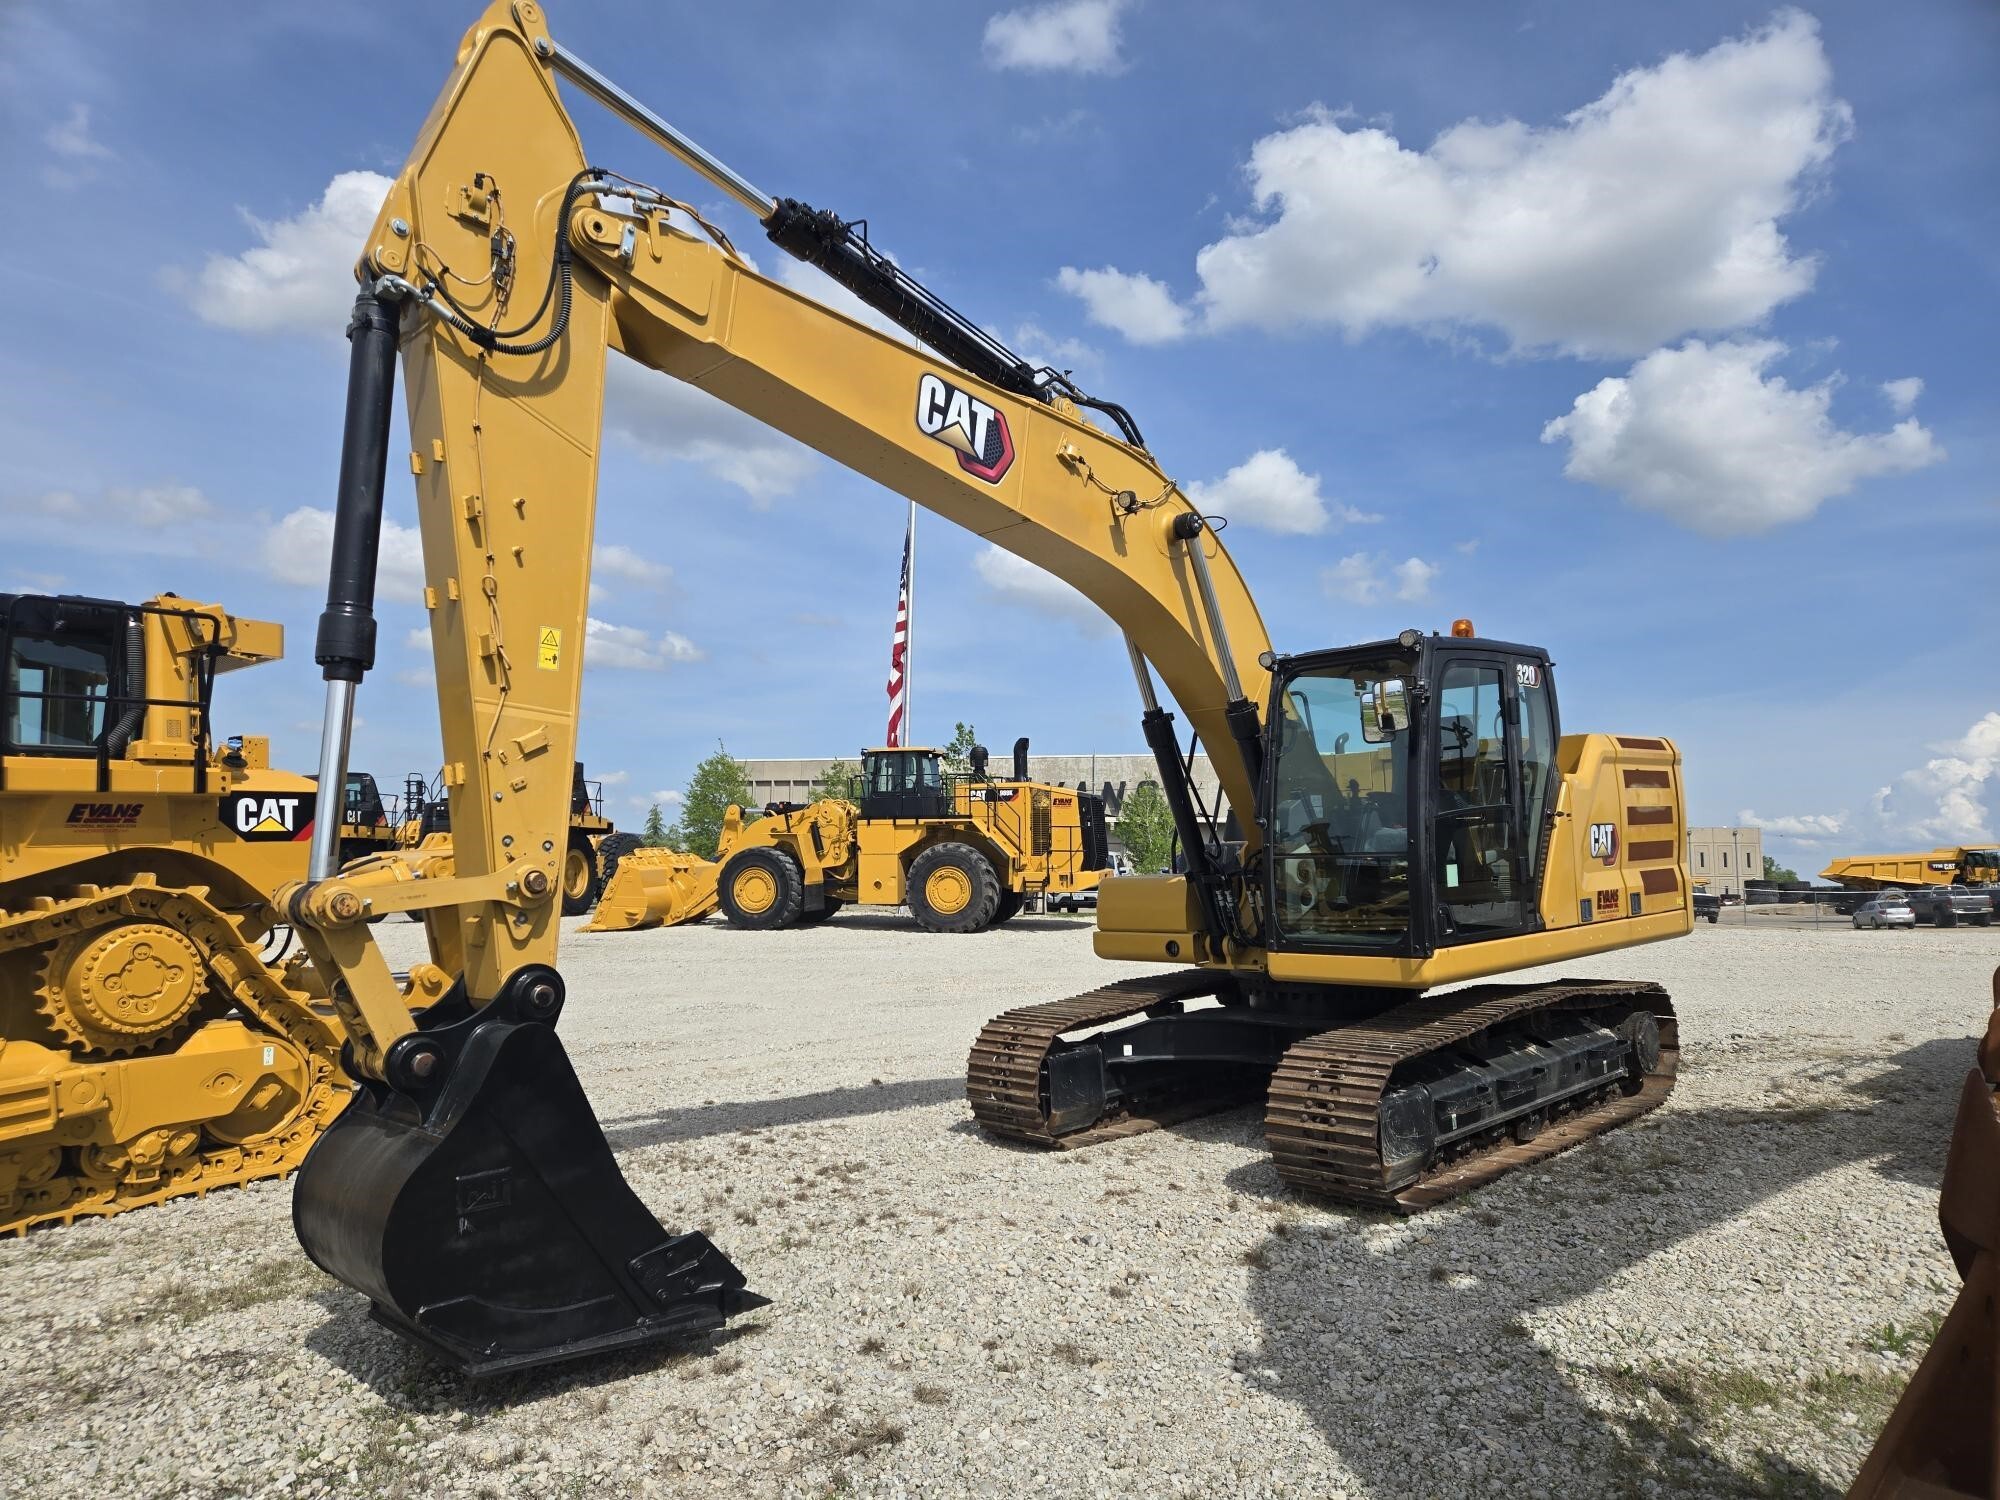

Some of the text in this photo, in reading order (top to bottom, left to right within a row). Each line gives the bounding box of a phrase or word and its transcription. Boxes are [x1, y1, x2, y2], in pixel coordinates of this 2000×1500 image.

[918, 375, 995, 460] CAT
[1516, 663, 1536, 685] 320
[970, 790, 986, 801] CAT
[1053, 798, 1072, 806] EVANS
[66, 803, 144, 823] EVANS
[236, 797, 299, 832] CAT
[1590, 824, 1613, 856] CAT
